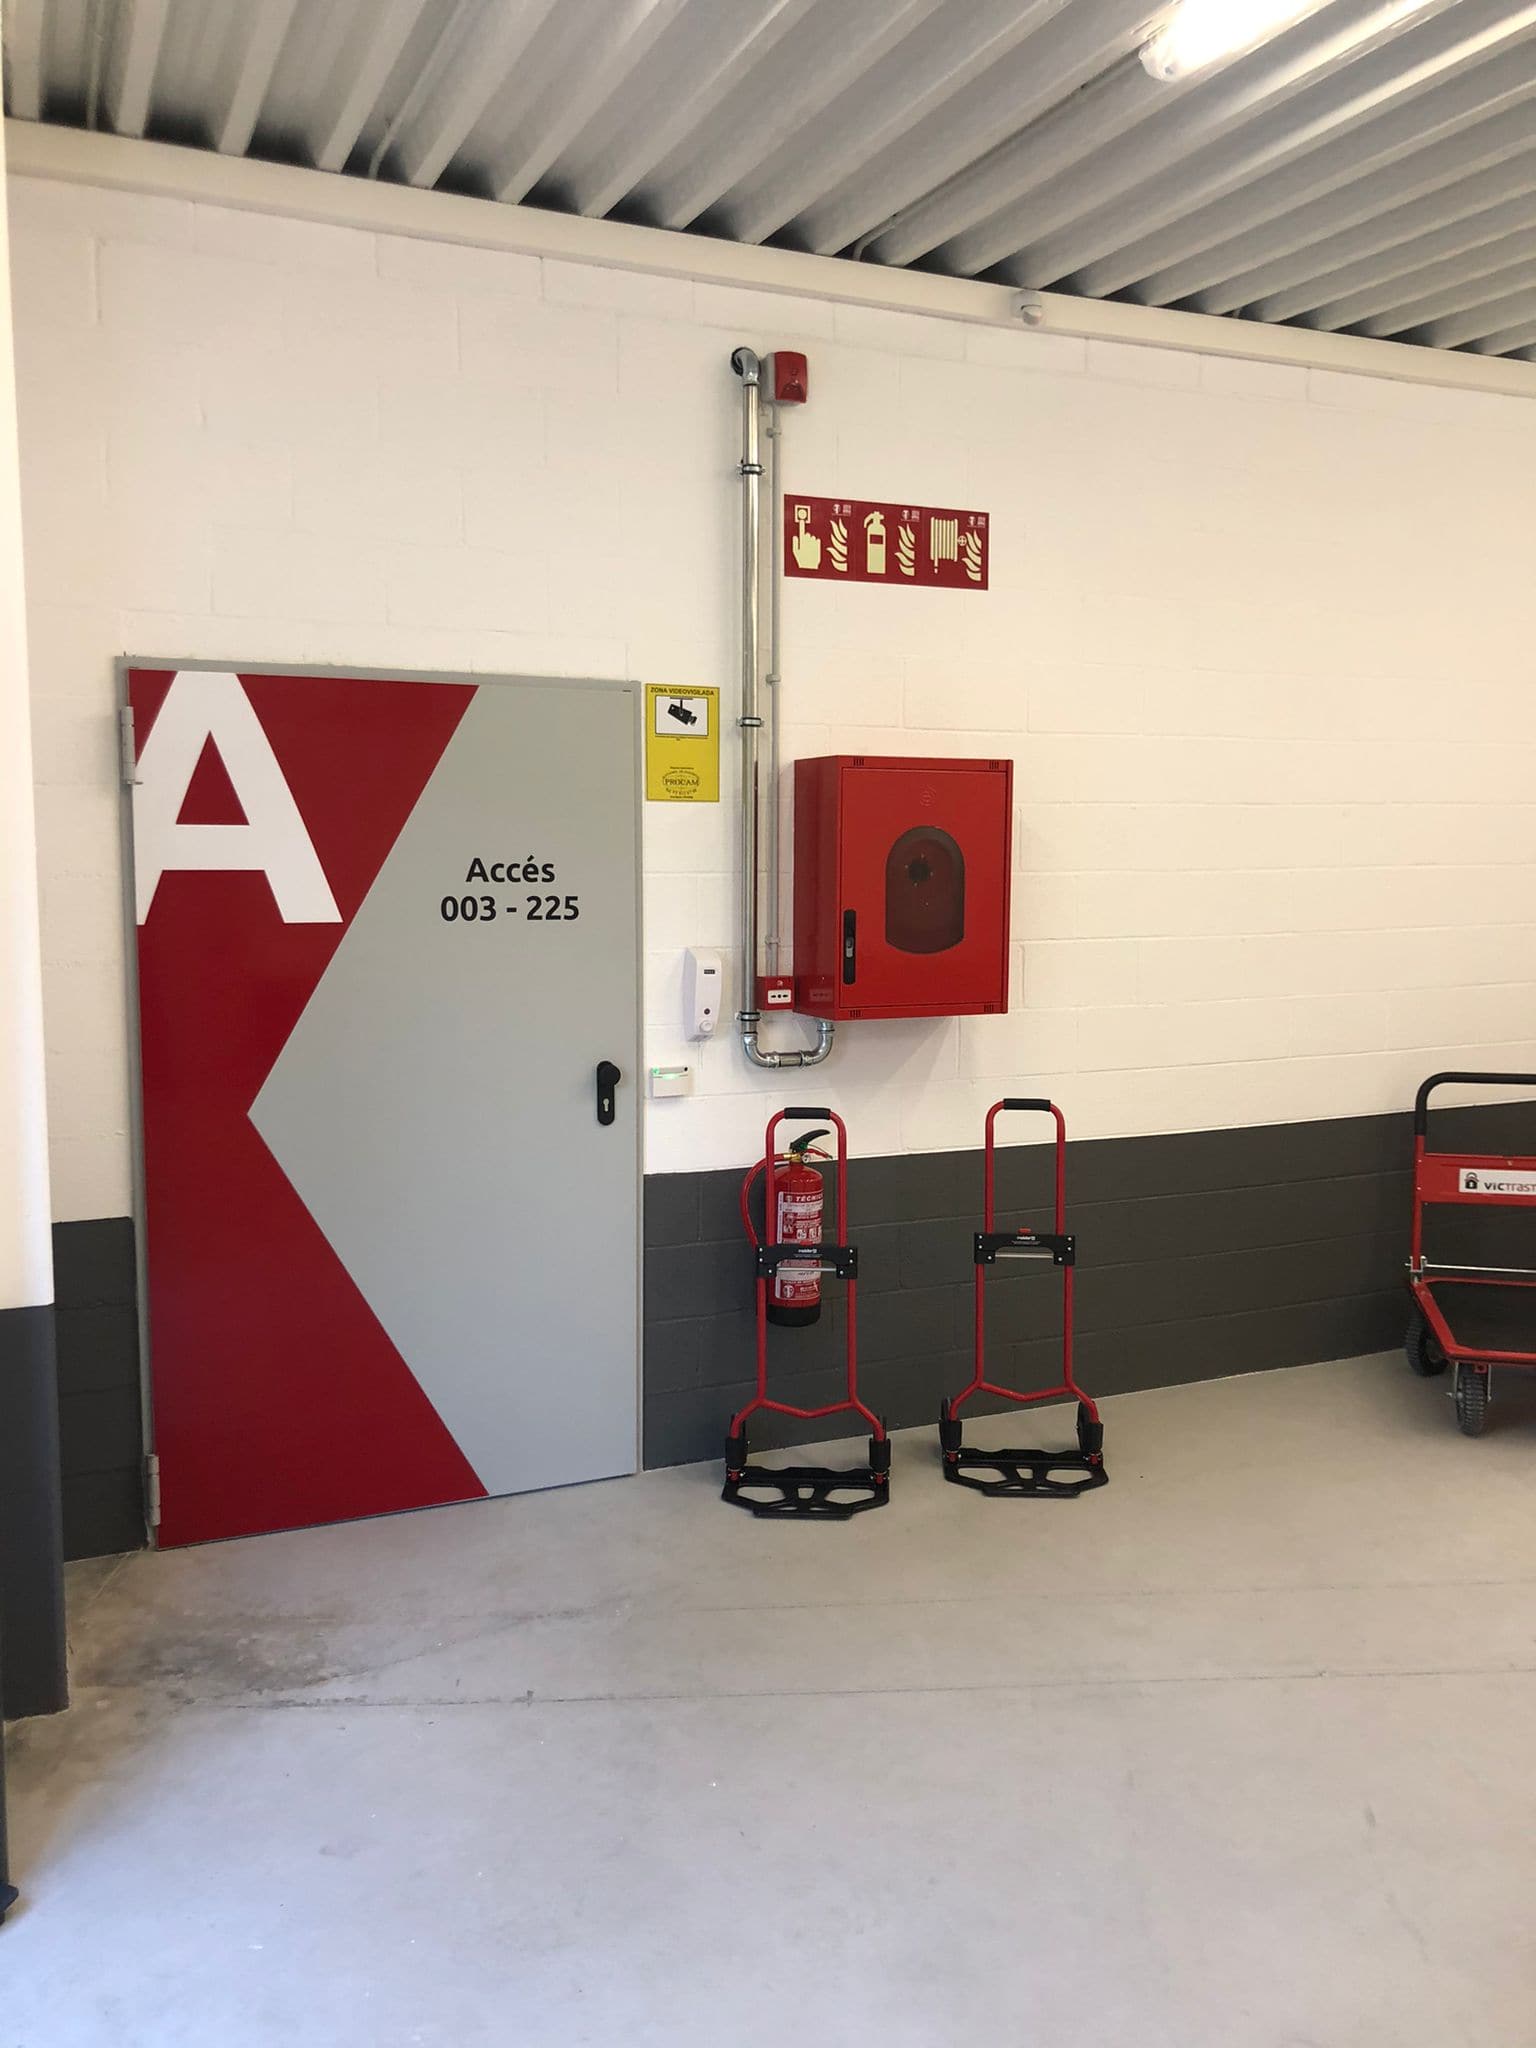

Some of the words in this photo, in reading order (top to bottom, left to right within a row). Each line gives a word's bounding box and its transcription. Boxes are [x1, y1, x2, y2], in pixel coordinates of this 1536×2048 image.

[650, 686, 668, 694] ZONA
[668, 687, 715, 696] VIDEOVIGILADA
[132, 671, 344, 926] A
[465, 854, 556, 883] Accés
[440, 895, 497, 922] 003
[526, 895, 580, 921] 225
